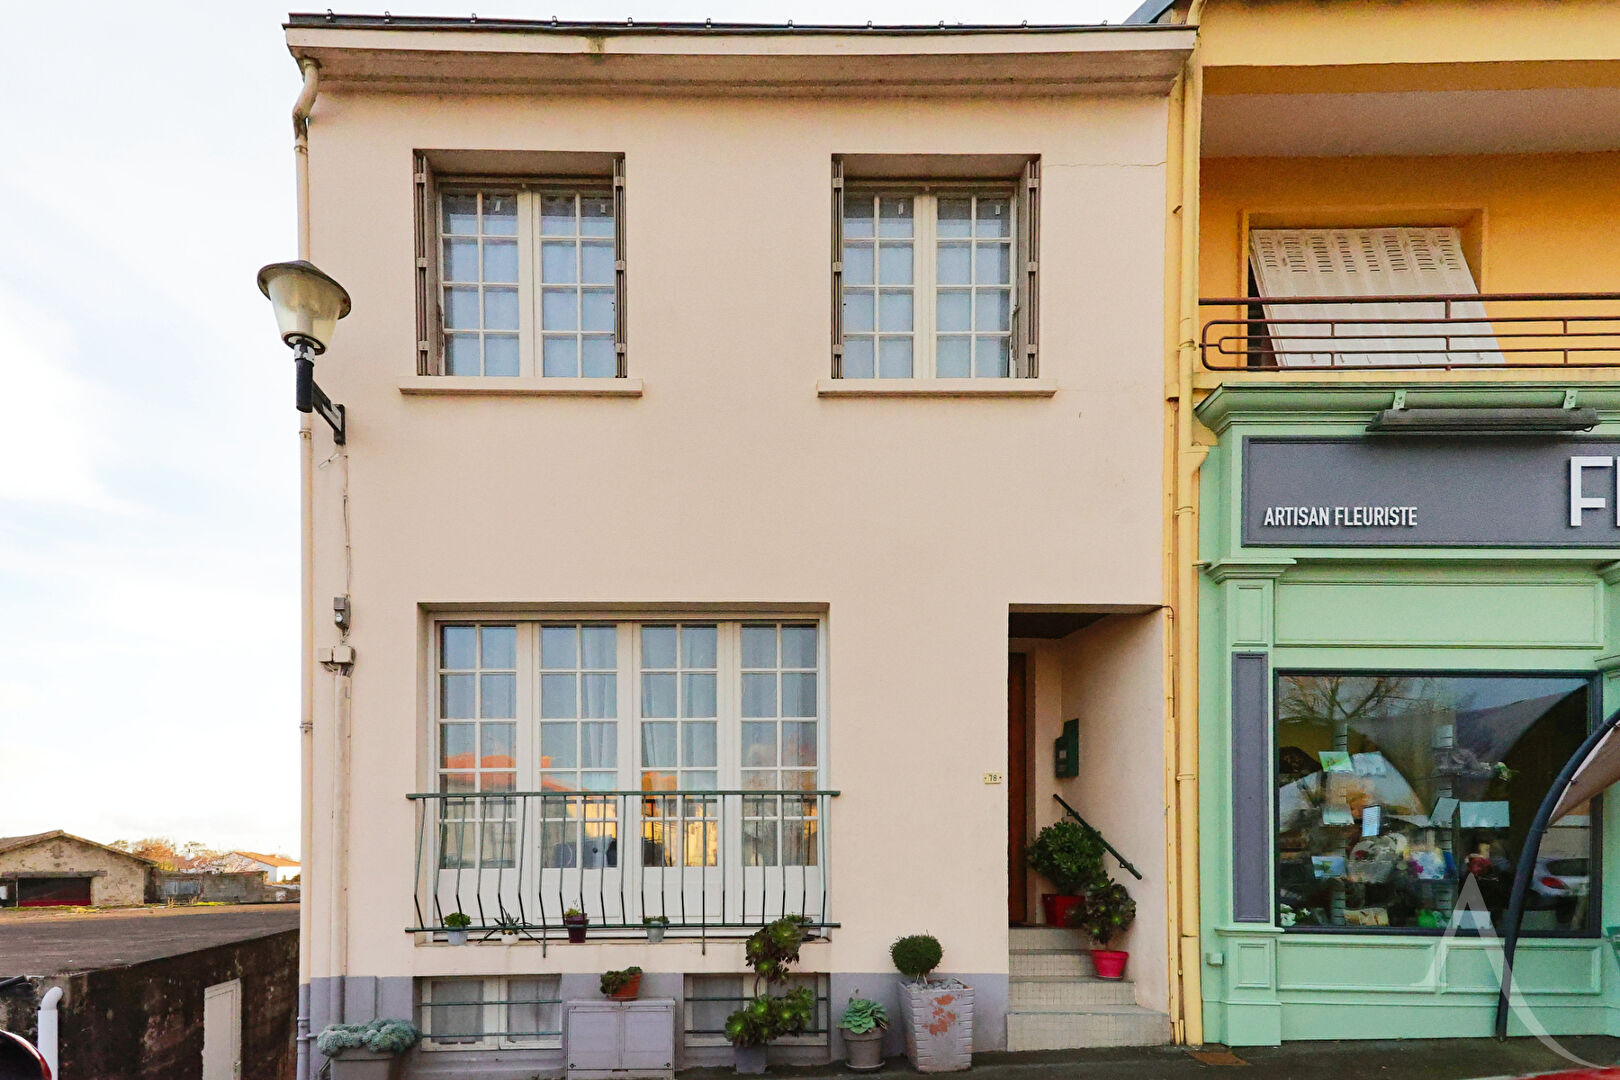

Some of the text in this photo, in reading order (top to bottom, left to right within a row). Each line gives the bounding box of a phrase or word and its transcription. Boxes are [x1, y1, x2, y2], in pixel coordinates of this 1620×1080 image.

[1571, 456, 1620, 527] F
[1264, 506, 1418, 526] ARTISAN FLEURISTE
